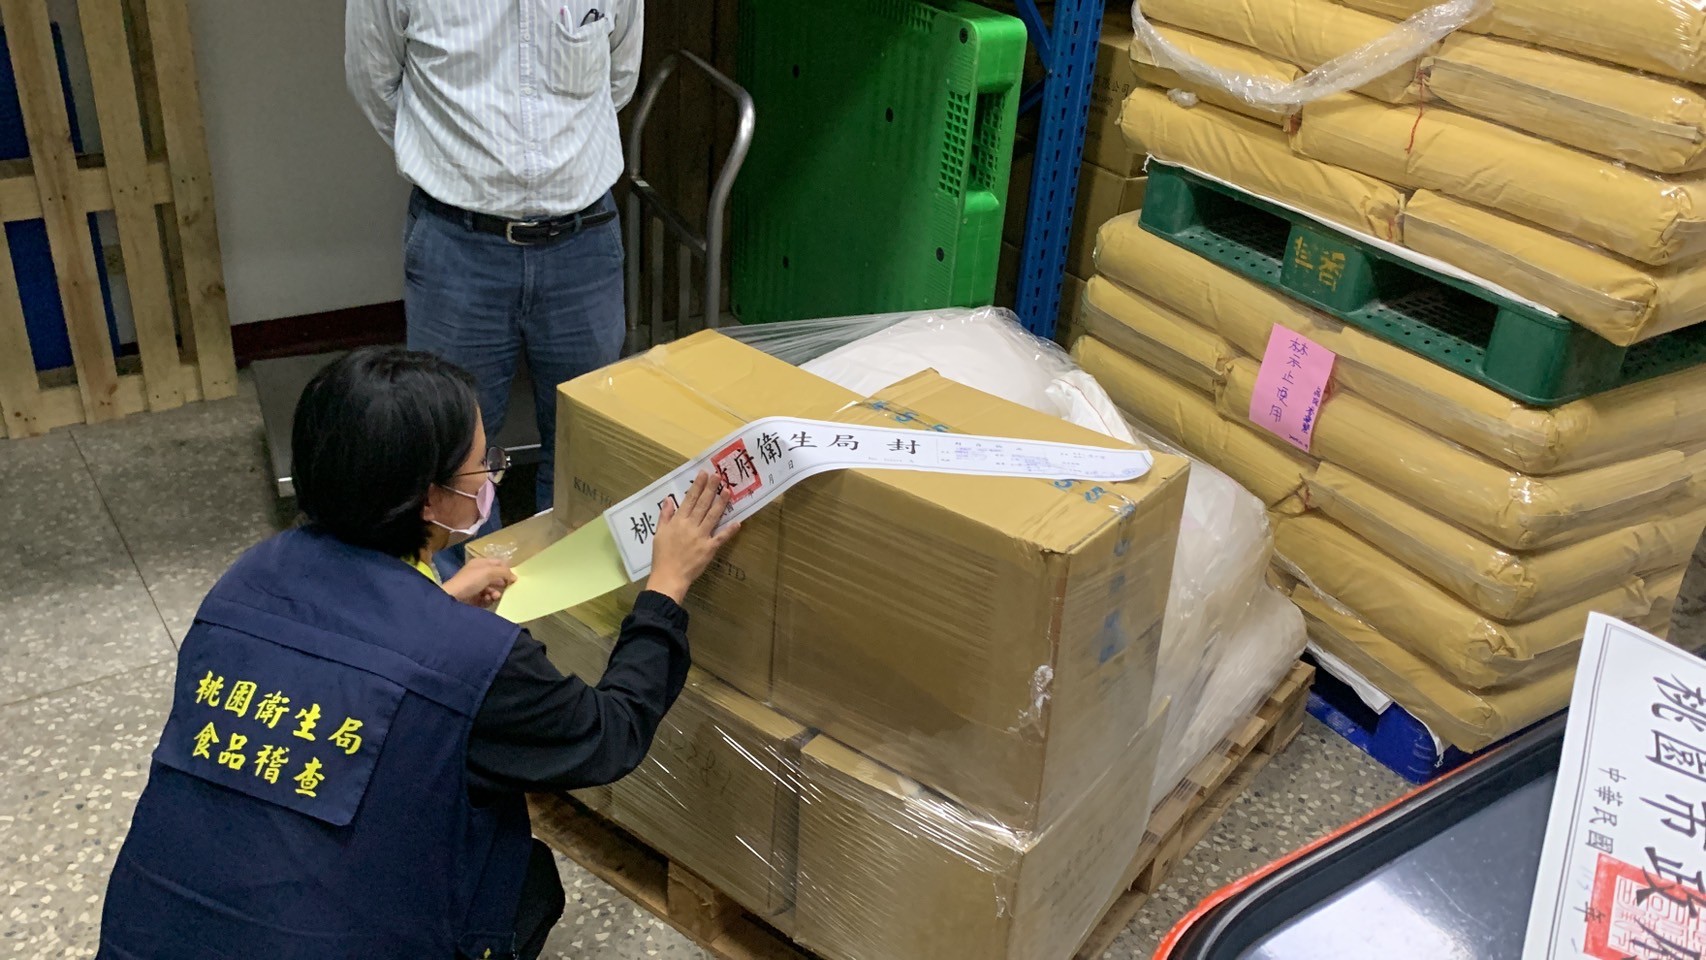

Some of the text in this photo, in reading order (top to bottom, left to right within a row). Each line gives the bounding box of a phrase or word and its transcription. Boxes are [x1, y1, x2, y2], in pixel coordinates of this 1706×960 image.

[195, 670, 364, 755] 桃園衛生局
[192, 721, 325, 798] 食品稽查
[1585, 766, 1627, 854] 中華民國
